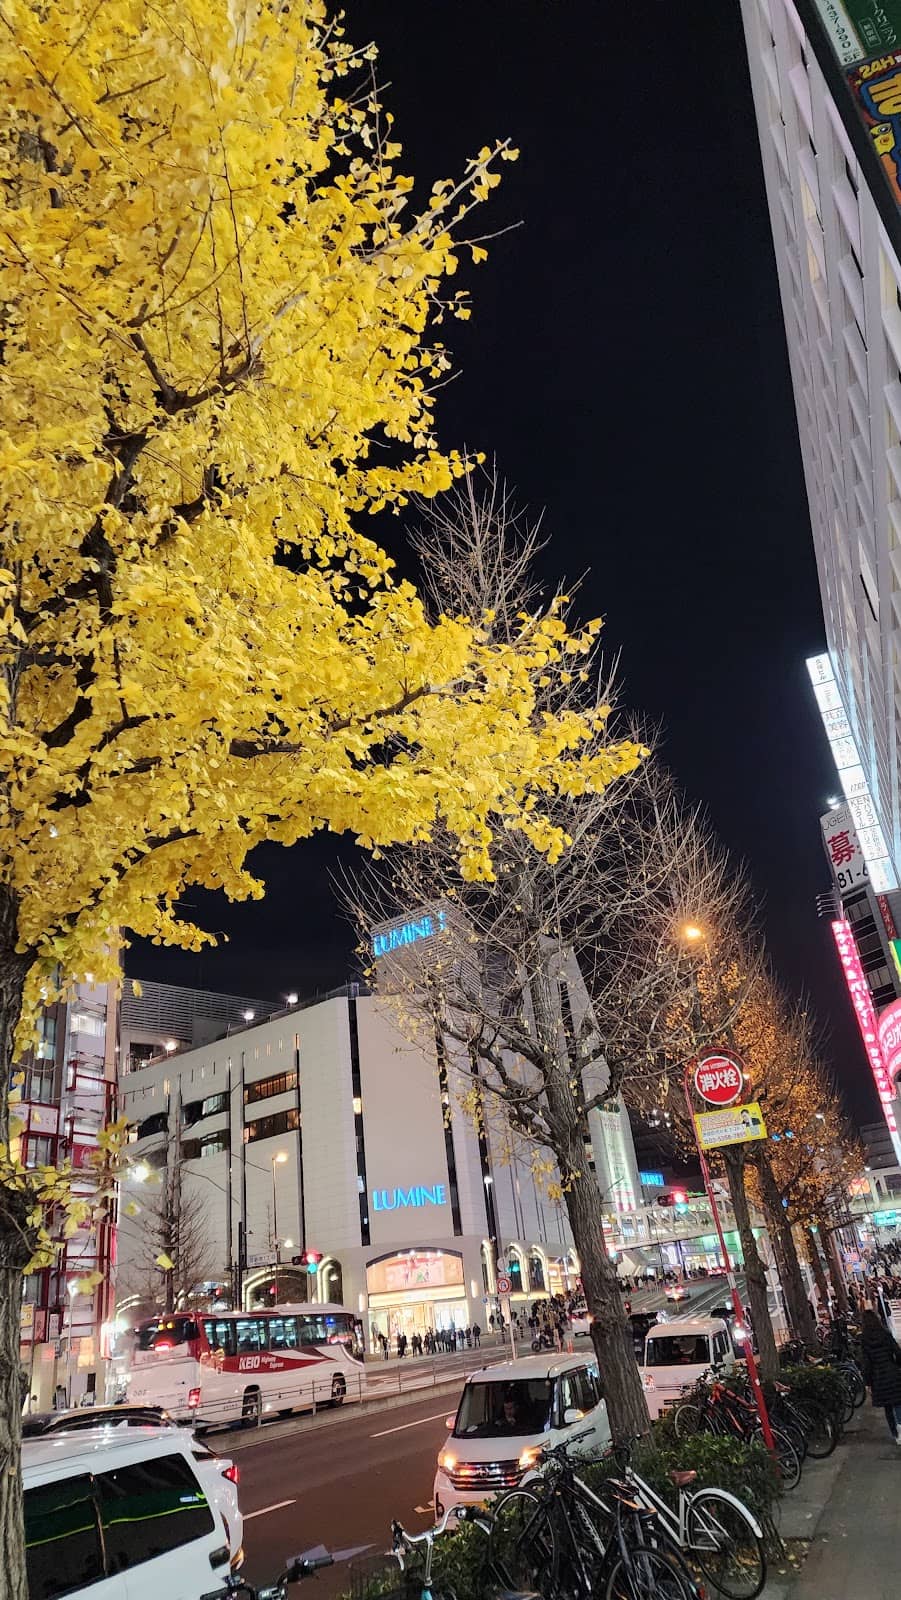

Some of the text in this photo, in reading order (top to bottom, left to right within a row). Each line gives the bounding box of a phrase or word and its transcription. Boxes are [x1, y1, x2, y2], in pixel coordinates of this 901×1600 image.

[859, 55, 896, 79] 24H
[699, 1068, 739, 1092] 消火栓
[372, 1184, 447, 1211] LUMINE
[239, 1355, 260, 1370] KEIO
